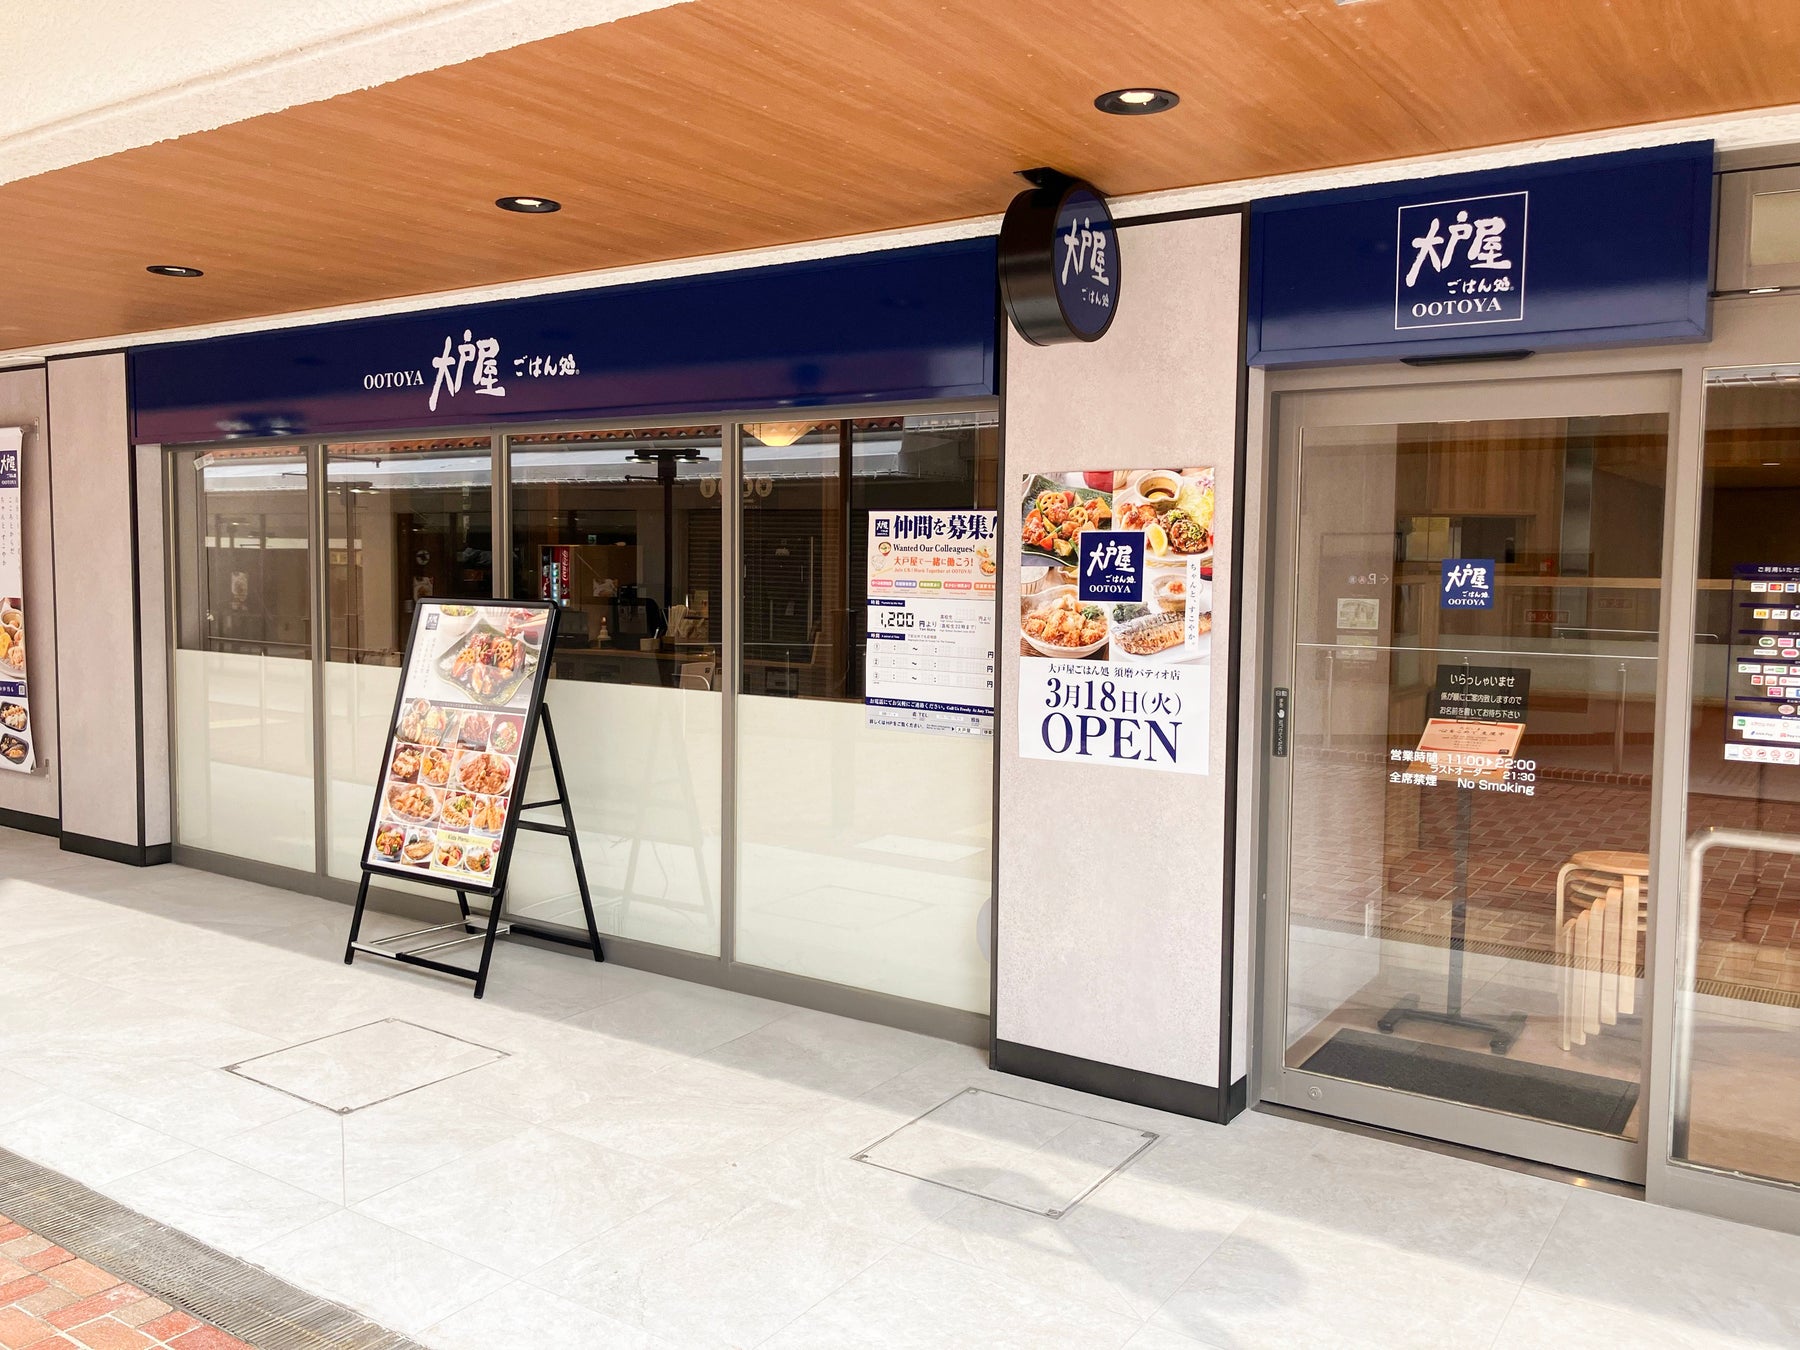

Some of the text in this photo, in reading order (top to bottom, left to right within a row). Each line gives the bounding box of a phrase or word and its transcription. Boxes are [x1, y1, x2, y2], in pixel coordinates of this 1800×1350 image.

[1061, 217, 1110, 286] 大戸屋
[1405, 210, 1512, 288] 大戸屋
[1411, 297, 1502, 318] OOTOYA
[363, 370, 424, 390] OOTOYA
[428, 329, 506, 412] 大戸屋
[893, 543, 976, 555] Wanted Our Colleagues!
[1086, 540, 1136, 577] 大戸屋
[1444, 563, 1490, 593] 大戸屋
[1088, 584, 1132, 594] OOTOYA
[1447, 598, 1486, 606] OOTOYA
[880, 611, 915, 628] 1,200
[919, 620, 937, 628] 円より
[987, 651, 994, 659] 円
[986, 665, 993, 673] 円
[1048, 663, 1181, 681] 大戸屋ごはん処 須磨パティオ店
[986, 680, 993, 688] 円
[1450, 673, 1515, 688] いらっしゃいませ
[1045, 677, 1182, 716] 3月18日(火)
[1439, 706, 1521, 719] お名前を書いてお待ち下さい
[1041, 712, 1183, 764] OPEN
[1390, 749, 1536, 771] 営業時間 11:00 22:00
[1430, 764, 1536, 782] ラストオーダー 21:30
[1389, 771, 1535, 796] 全席禁煙 No Smoking
